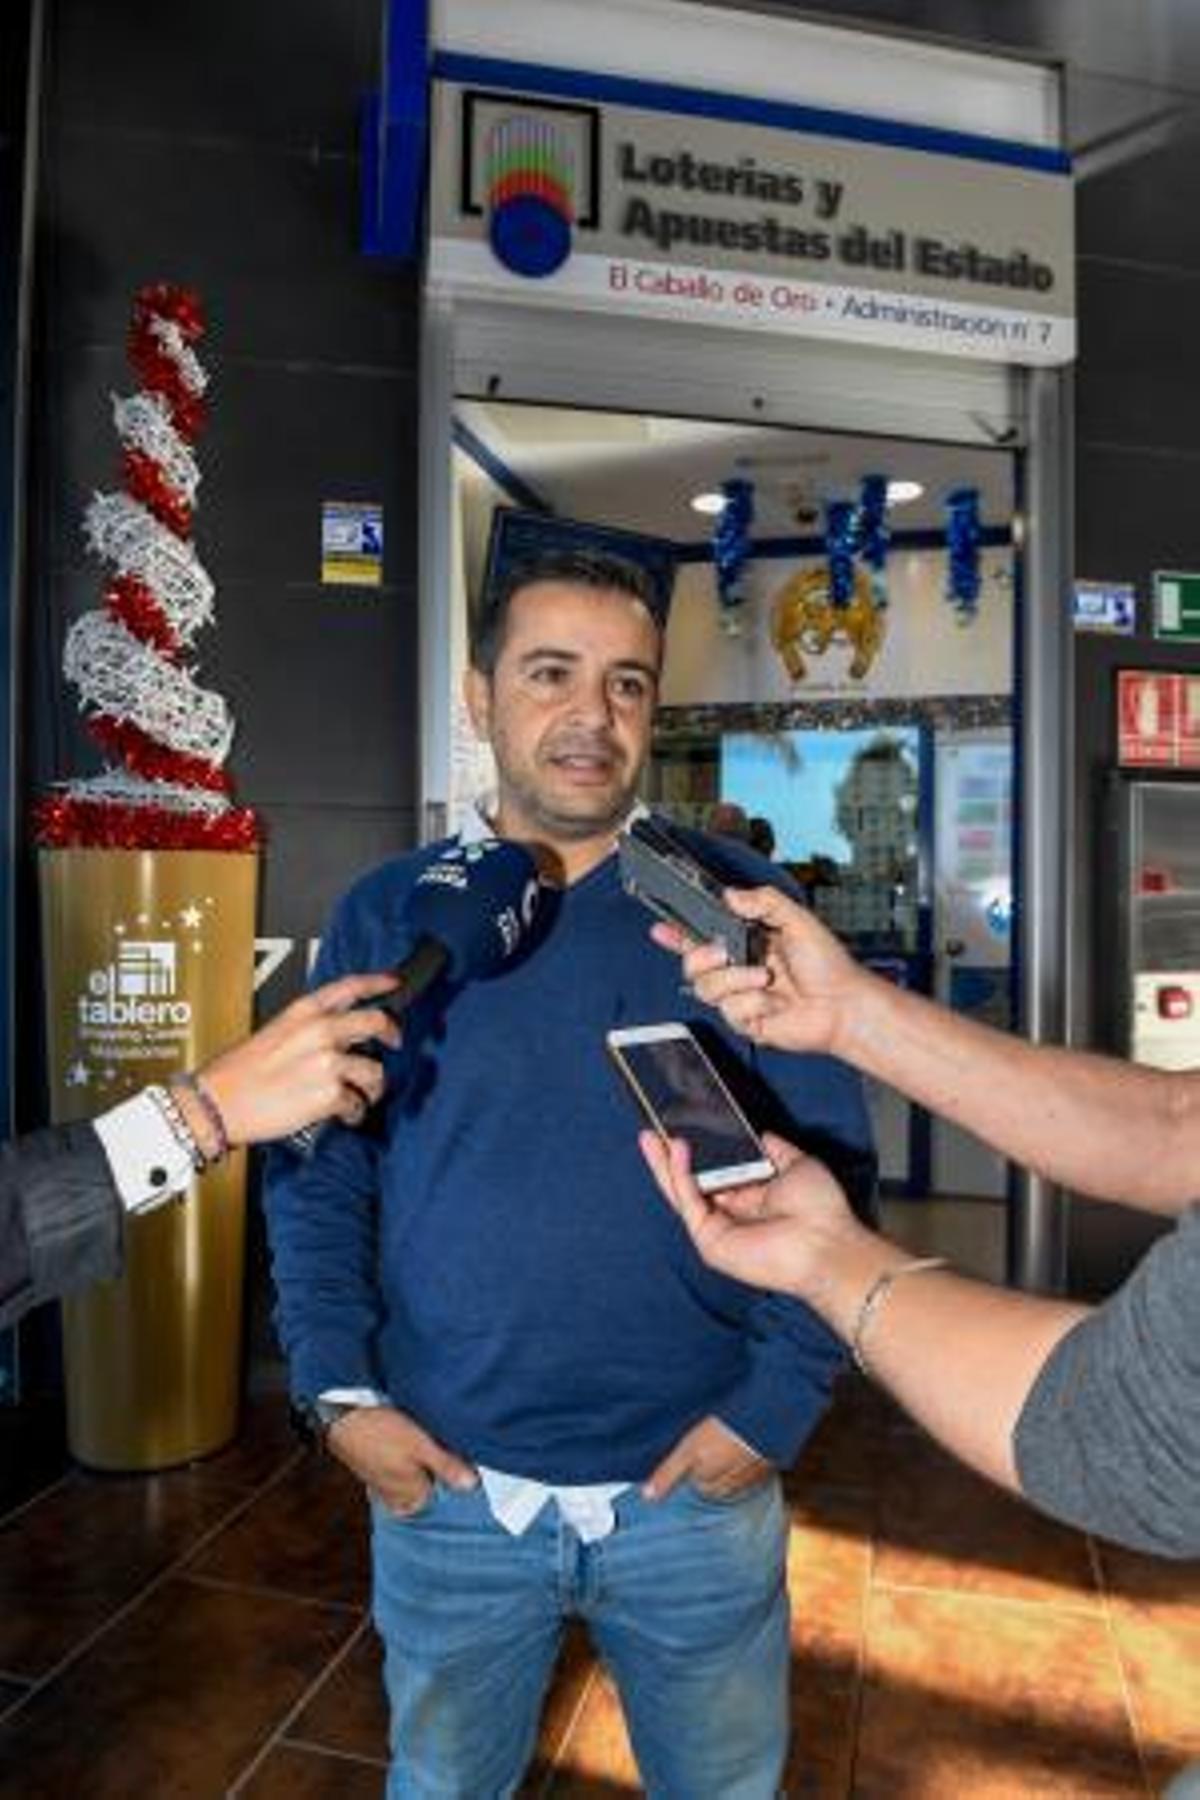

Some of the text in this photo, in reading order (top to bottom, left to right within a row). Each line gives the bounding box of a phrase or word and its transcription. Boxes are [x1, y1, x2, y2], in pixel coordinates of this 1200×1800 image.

[815, 180, 843, 219] y
[621, 196, 1054, 292] Apuestas del Estado
[609, 265, 627, 289] El
[634, 269, 724, 302] Caballo
[733, 282, 763, 307] de
[770, 286, 818, 312] Oro
[1038, 320, 1053, 345] 7
[89, 963, 115, 998] el
[79, 995, 192, 1024] tablero
